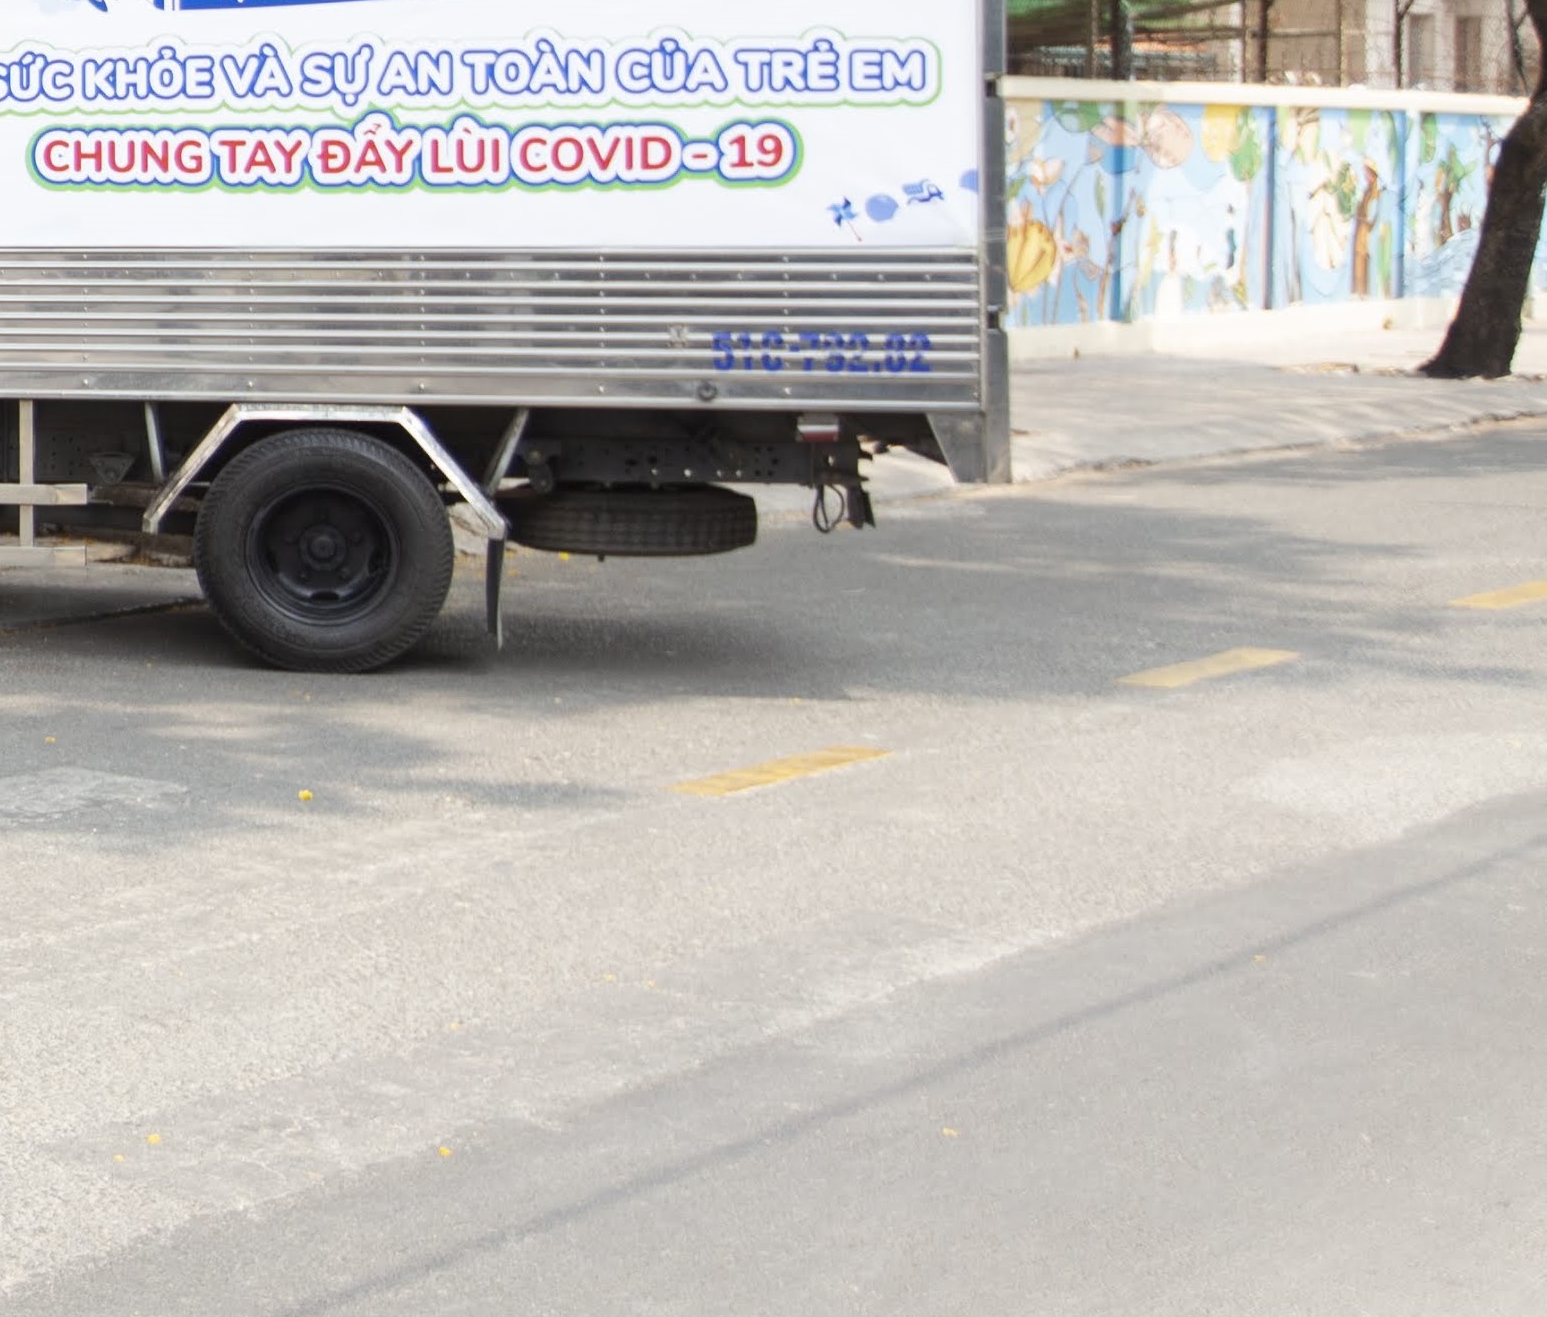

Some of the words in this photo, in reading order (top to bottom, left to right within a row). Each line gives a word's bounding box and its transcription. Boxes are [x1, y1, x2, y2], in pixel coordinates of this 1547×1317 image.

[82, 44, 215, 101] KHỎE
[221, 43, 294, 99] VÀ
[300, 43, 374, 107] SỰ
[378, 51, 455, 97] AN
[461, 37, 606, 95] TOÀN
[614, 38, 728, 94] CỦA
[735, 38, 840, 93] TRẺ
[847, 48, 926, 93] EM
[42, 138, 205, 175] CHUNG
[218, 138, 304, 175] TAY
[316, 122, 415, 175] ĐẨY
[429, 127, 501, 174] LÙI
[518, 134, 674, 173] COVID
[726, 133, 784, 169] 19
